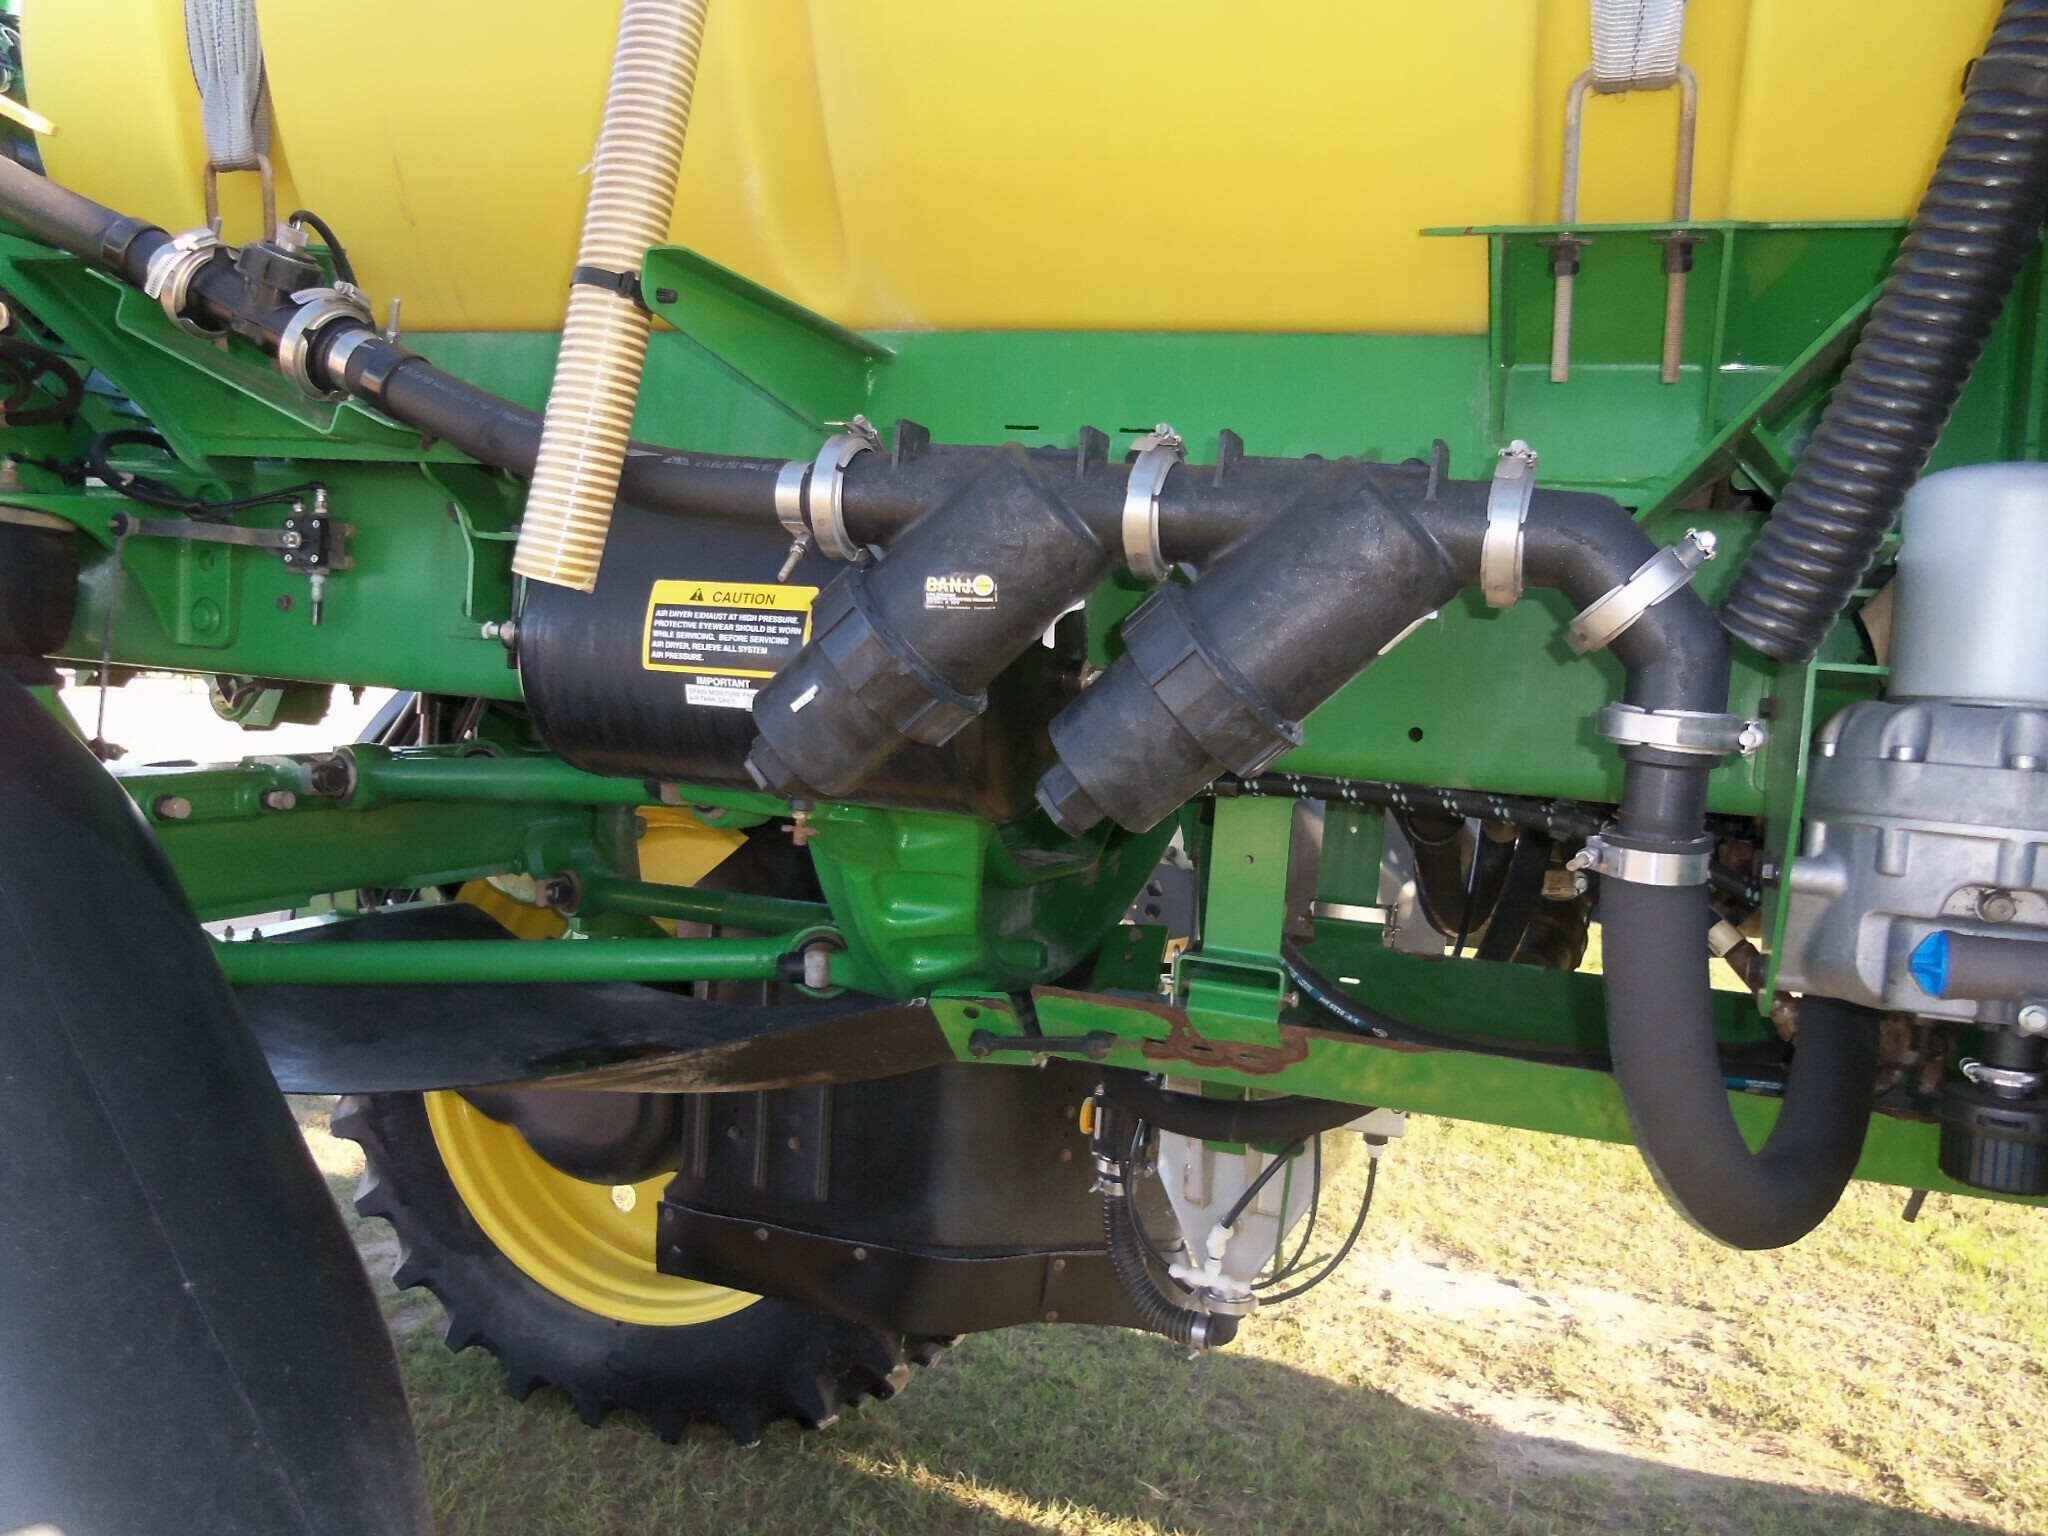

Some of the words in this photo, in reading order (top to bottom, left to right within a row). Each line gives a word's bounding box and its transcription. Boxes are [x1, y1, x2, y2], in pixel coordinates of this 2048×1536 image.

[926, 575, 994, 596] BANJO
[713, 591, 776, 605] CAUTION
[655, 609, 668, 617] AIR
[669, 610, 693, 618] DRYER
[694, 612, 728, 620] EXHAUST
[728, 613, 739, 621] AT
[739, 613, 757, 622] HIGH
[758, 615, 799, 624] PRESSURE.
[654, 619, 697, 629] PROTECTIVE
[699, 622, 734, 631] EYEWEAR
[735, 624, 766, 633] SHOULD
[767, 626, 777, 634] BE
[779, 627, 802, 635] WORN
[652, 629, 675, 638] WHILE
[676, 631, 716, 640] SERVICING.
[719, 634, 749, 642] BEFORE
[750, 636, 789, 645] SERVICING
[651, 640, 664, 648] AIR
[665, 641, 691, 651] DRYER,
[692, 643, 722, 651] RELIEVE
[723, 645, 737, 653] ALL
[738, 646, 768, 655] SYSTEM
[651, 651, 664, 659] AIR
[664, 652, 704, 661] PRESSURE.
[696, 676, 751, 689] IMPORTANT
[688, 687, 706, 695] DRAIN
[709, 689, 740, 698] MOISTURE
